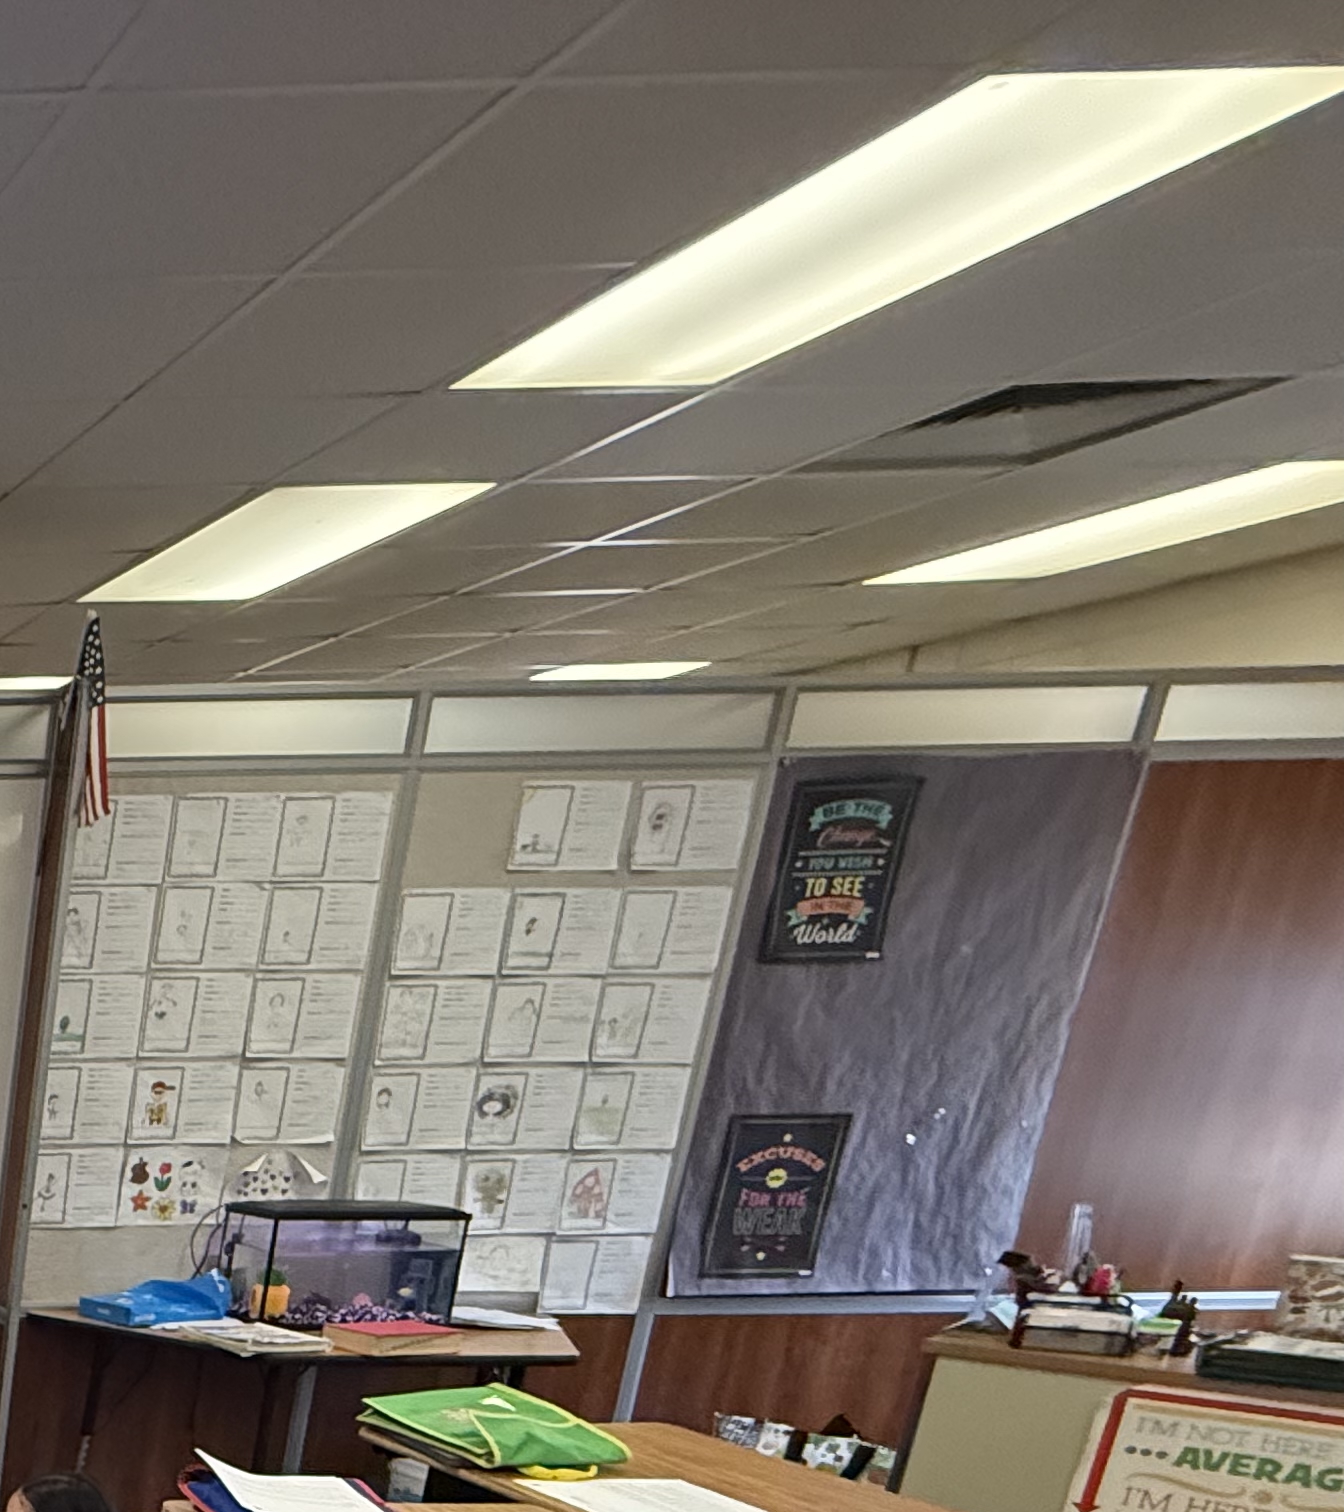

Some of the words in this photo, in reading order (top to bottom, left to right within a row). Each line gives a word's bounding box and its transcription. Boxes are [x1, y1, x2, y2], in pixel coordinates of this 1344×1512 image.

[822, 803, 847, 818] BE
[852, 801, 886, 814] THE
[805, 878, 828, 897] TO
[830, 876, 866, 897] SEE
[793, 923, 857, 945] World
[735, 1145, 826, 1173] EXCUSES
[739, 1188, 771, 1207] FOR
[777, 1189, 808, 1207] THE
[733, 1207, 806, 1236] WEAK
[1135, 1415, 1181, 1438] I'M
[1186, 1423, 1251, 1448] NOT
[1172, 1446, 1344, 1493] AVERAG
